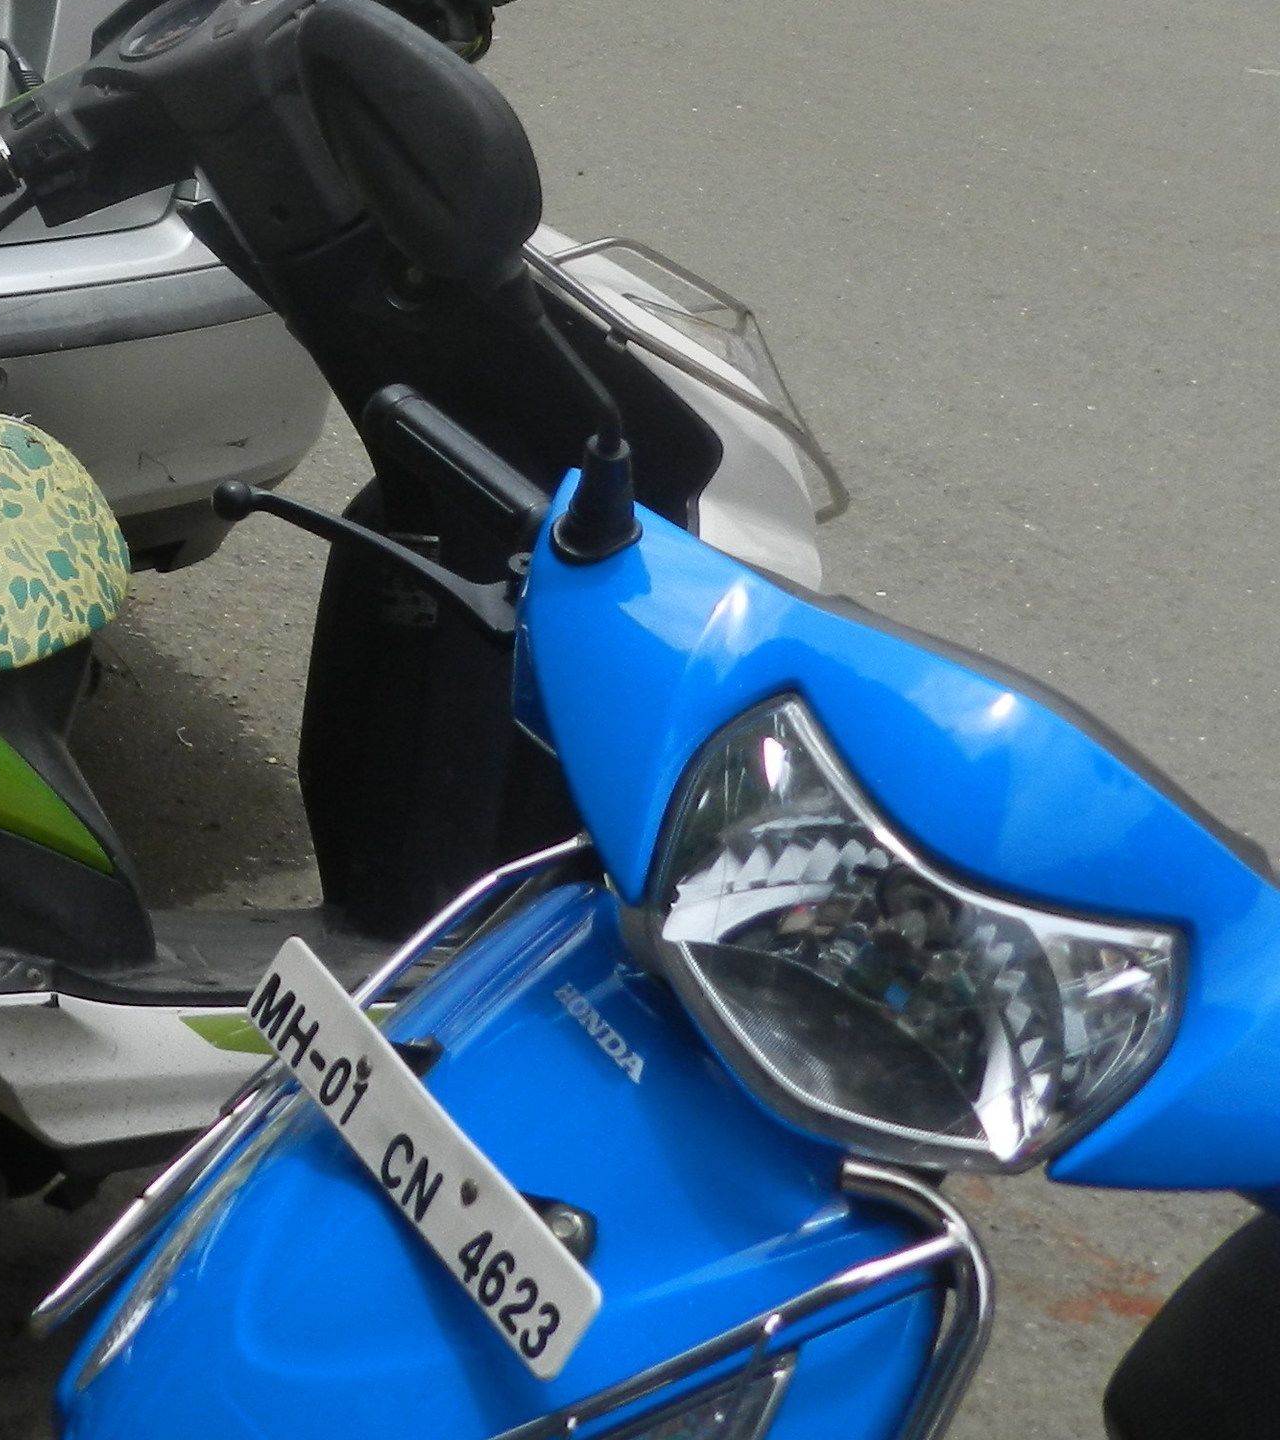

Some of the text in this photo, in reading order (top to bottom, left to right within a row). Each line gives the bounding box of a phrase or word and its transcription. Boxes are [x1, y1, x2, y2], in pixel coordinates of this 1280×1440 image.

[553, 981, 645, 1085] HONDA
[249, 972, 561, 1360] MH-01 CN 4623
